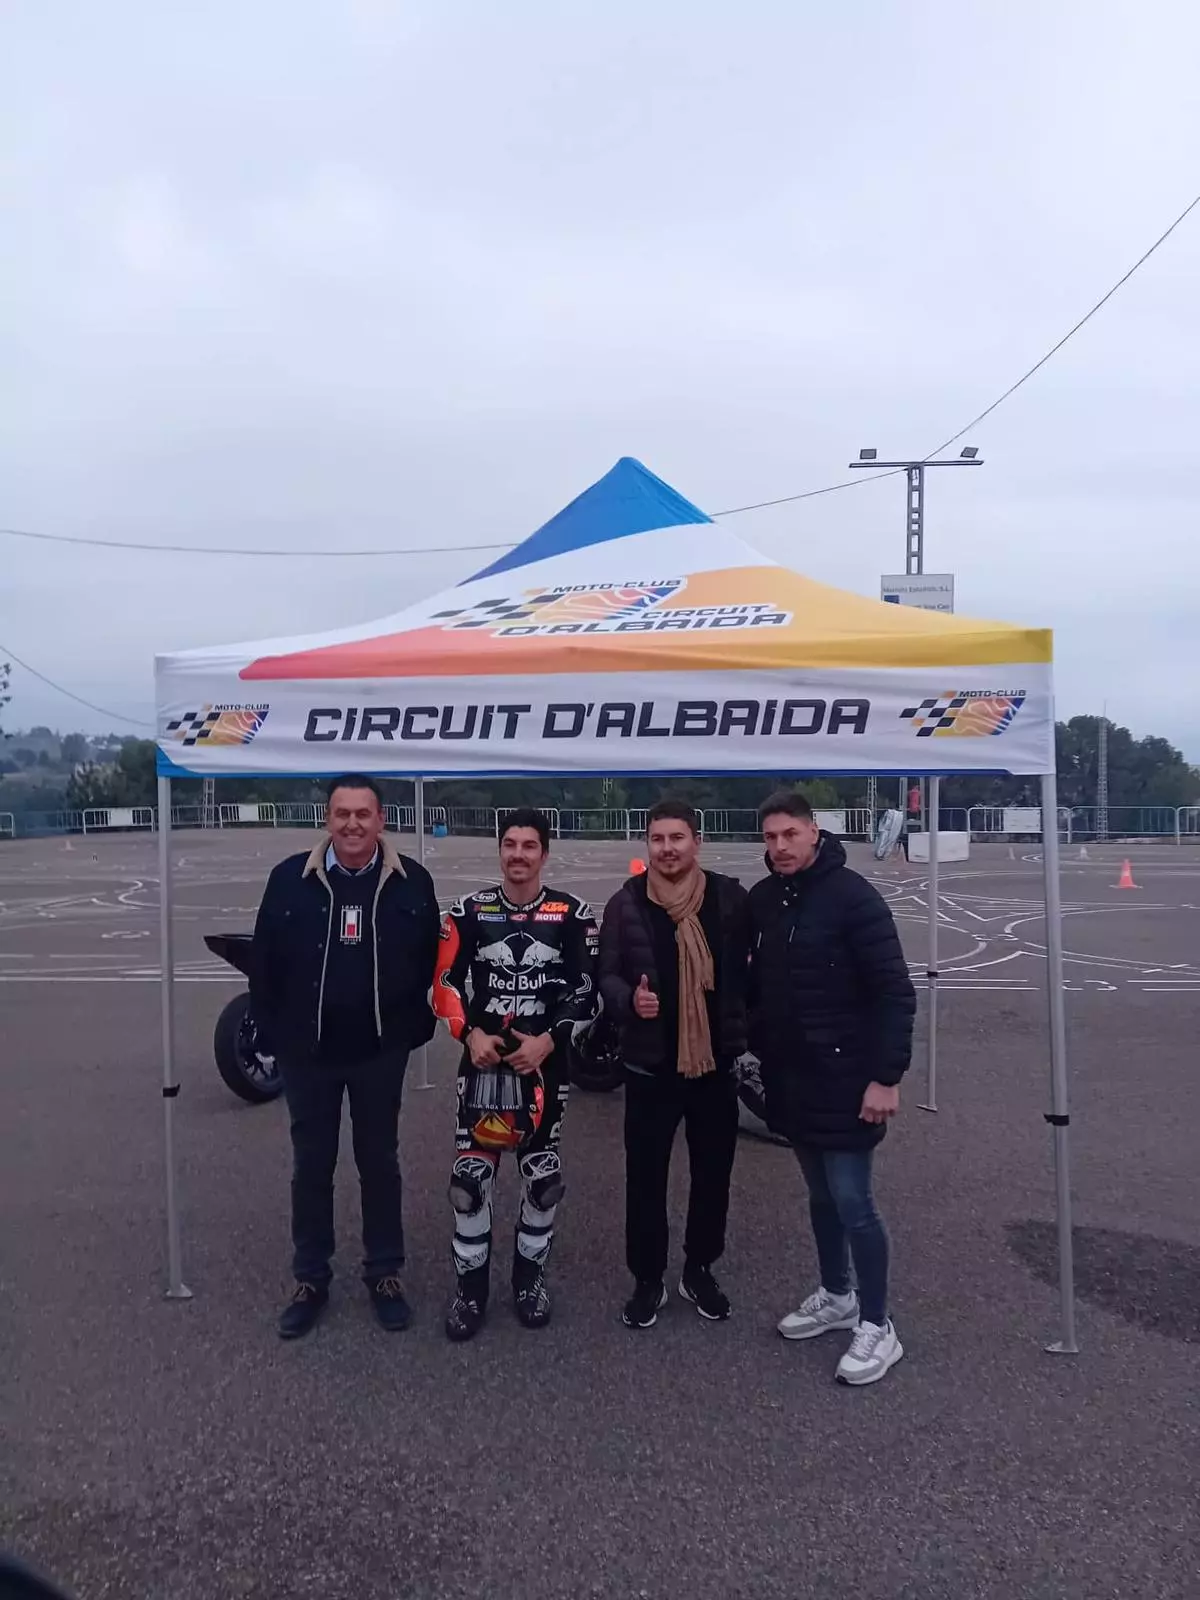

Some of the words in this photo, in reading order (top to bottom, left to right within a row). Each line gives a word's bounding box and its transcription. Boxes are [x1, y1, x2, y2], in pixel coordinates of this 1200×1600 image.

[552, 579, 682, 593] MOTO-CLUB
[641, 605, 769, 619] CIRCUIT
[498, 613, 788, 636] D'ALBAIDA
[958, 689, 1026, 698] MOTO-CLUB
[214, 703, 270, 711] MOTO-CLUB
[488, 972, 516, 991] Red
[518, 973, 546, 990] Bull
[484, 995, 546, 1016] KTM
